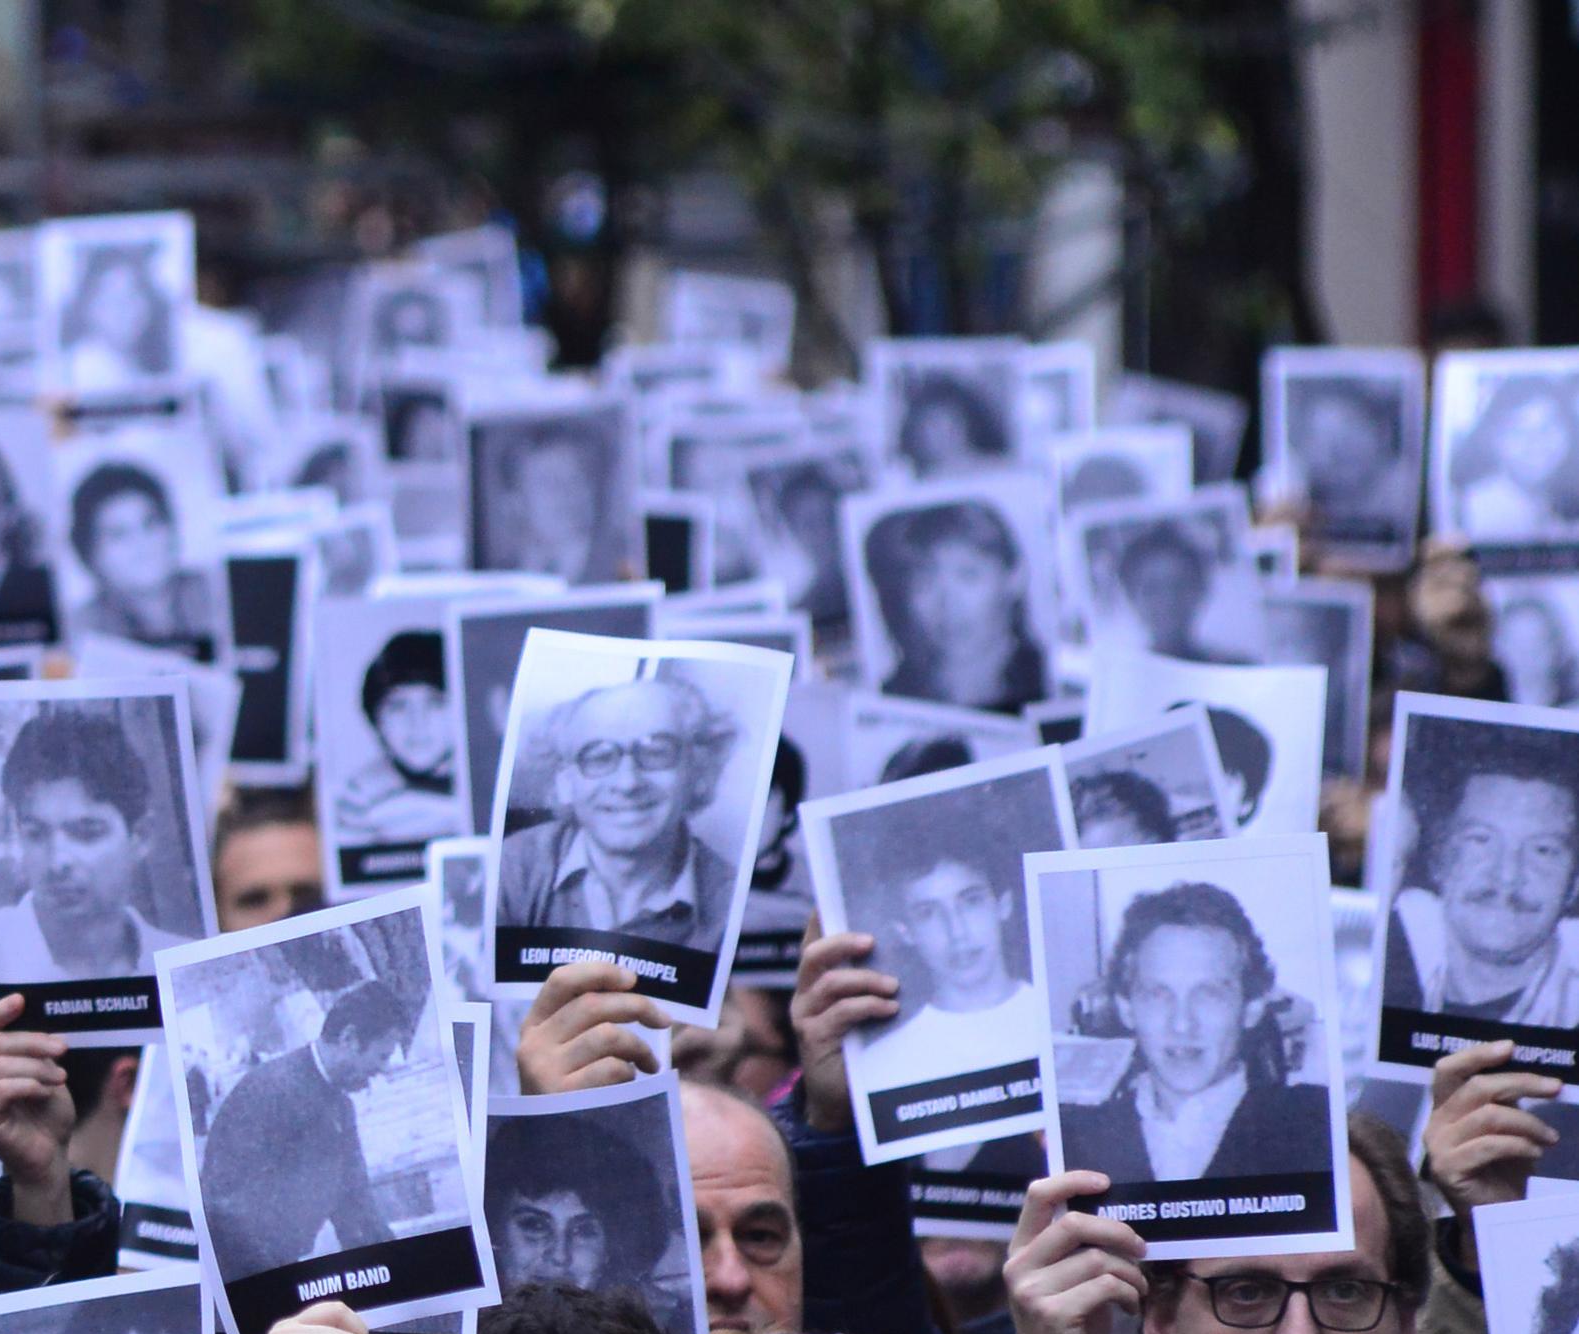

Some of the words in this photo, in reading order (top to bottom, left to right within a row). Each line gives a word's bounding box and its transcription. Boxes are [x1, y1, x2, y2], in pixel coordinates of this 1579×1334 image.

[522, 948, 549, 965] LEON
[619, 956, 678, 983] KNORPEL
[44, 999, 92, 1015] FABIAN
[96, 995, 149, 1012] SCHALIT
[1412, 1032, 1440, 1050] LUIS
[897, 1095, 957, 1121] GUSTAVO
[959, 1086, 1007, 1109] DANIEL
[1097, 1199, 1158, 1222] ANDRES
[1160, 1198, 1226, 1219] GUSTAVO
[1228, 1195, 1307, 1216] MALAMUD
[298, 1273, 343, 1302] NAUM
[345, 1266, 391, 1291] BAND
